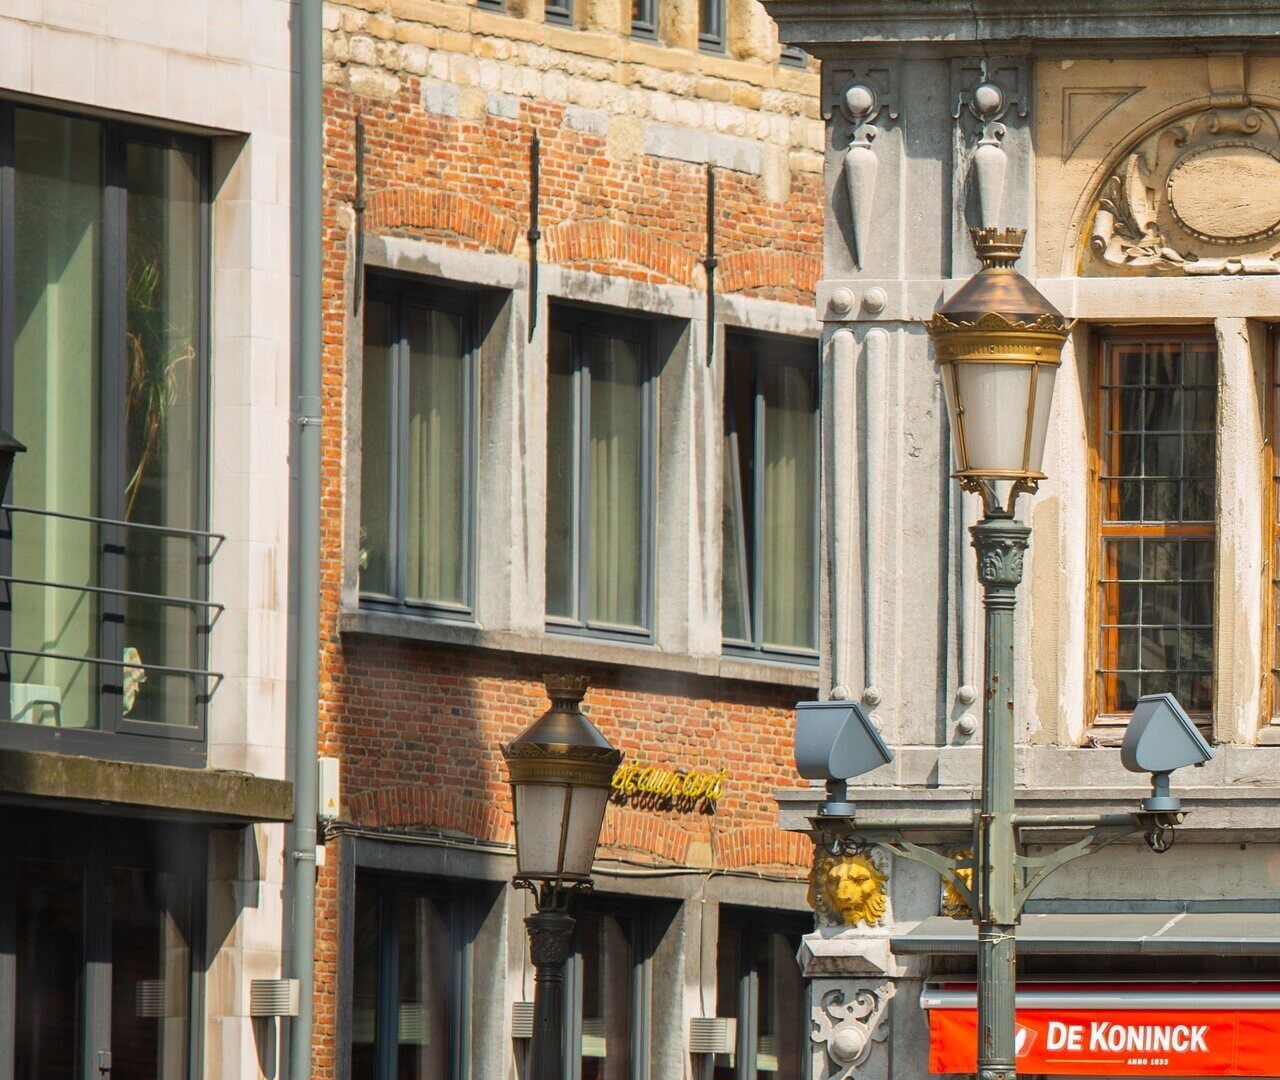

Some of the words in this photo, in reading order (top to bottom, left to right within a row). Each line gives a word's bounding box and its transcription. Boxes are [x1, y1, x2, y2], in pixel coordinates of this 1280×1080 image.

[611, 760, 726, 800] staurant
[1046, 1021, 1084, 1051] DE
[1089, 1021, 1210, 1052] KONINCK
[1127, 1058, 1148, 1066] ANNO
